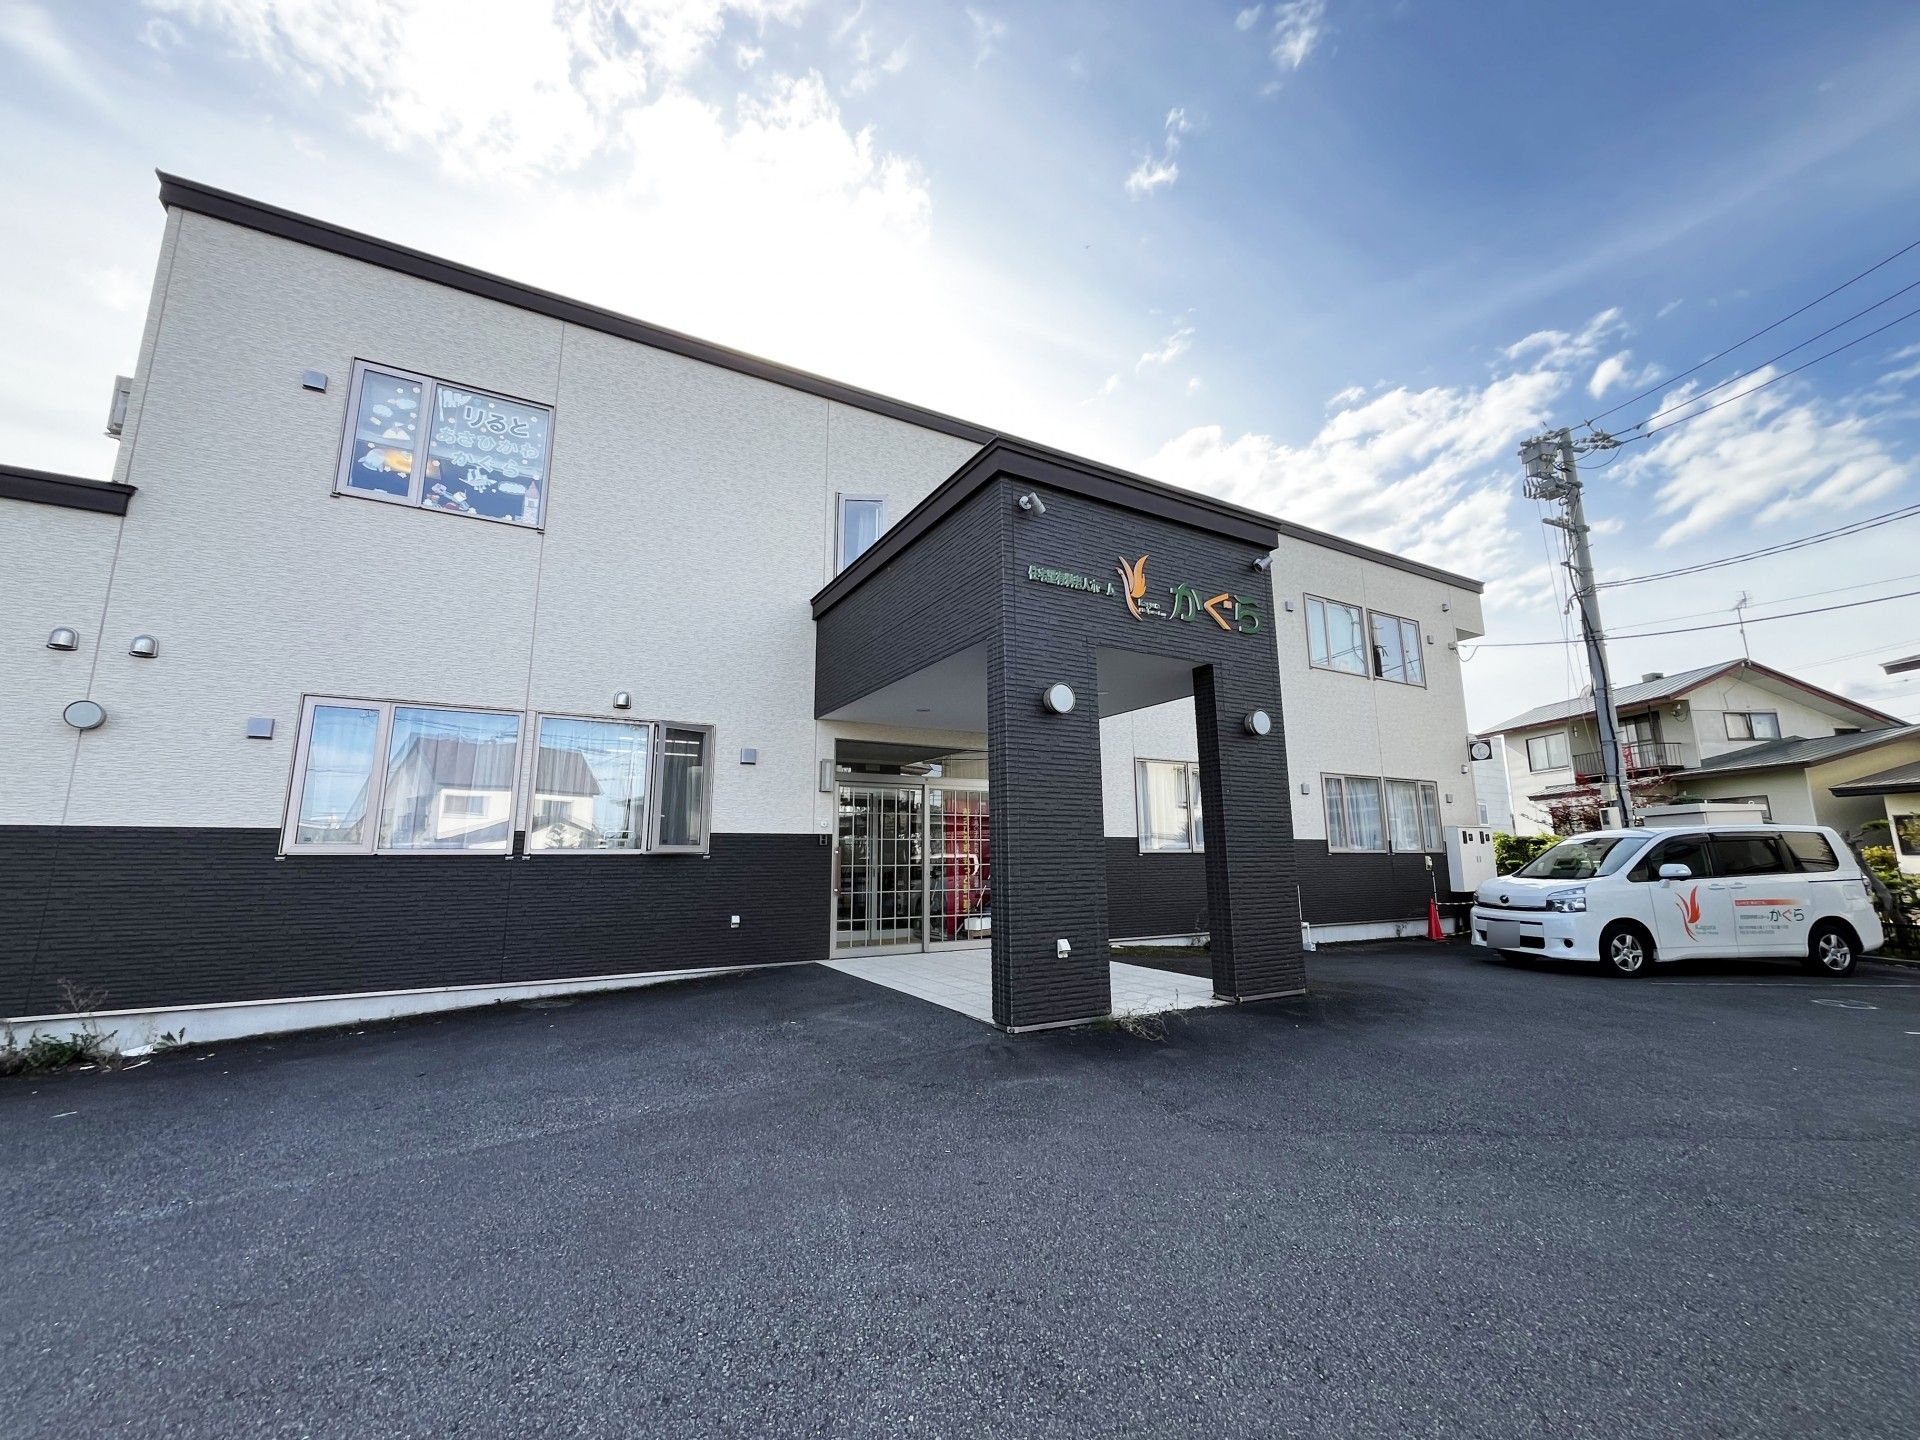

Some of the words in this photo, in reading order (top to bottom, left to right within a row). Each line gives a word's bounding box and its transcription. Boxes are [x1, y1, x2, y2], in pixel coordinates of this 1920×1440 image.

[464, 405, 529, 438] りると
[1168, 581, 1264, 634] かぐら
[1769, 908, 1806, 923] かぐら
